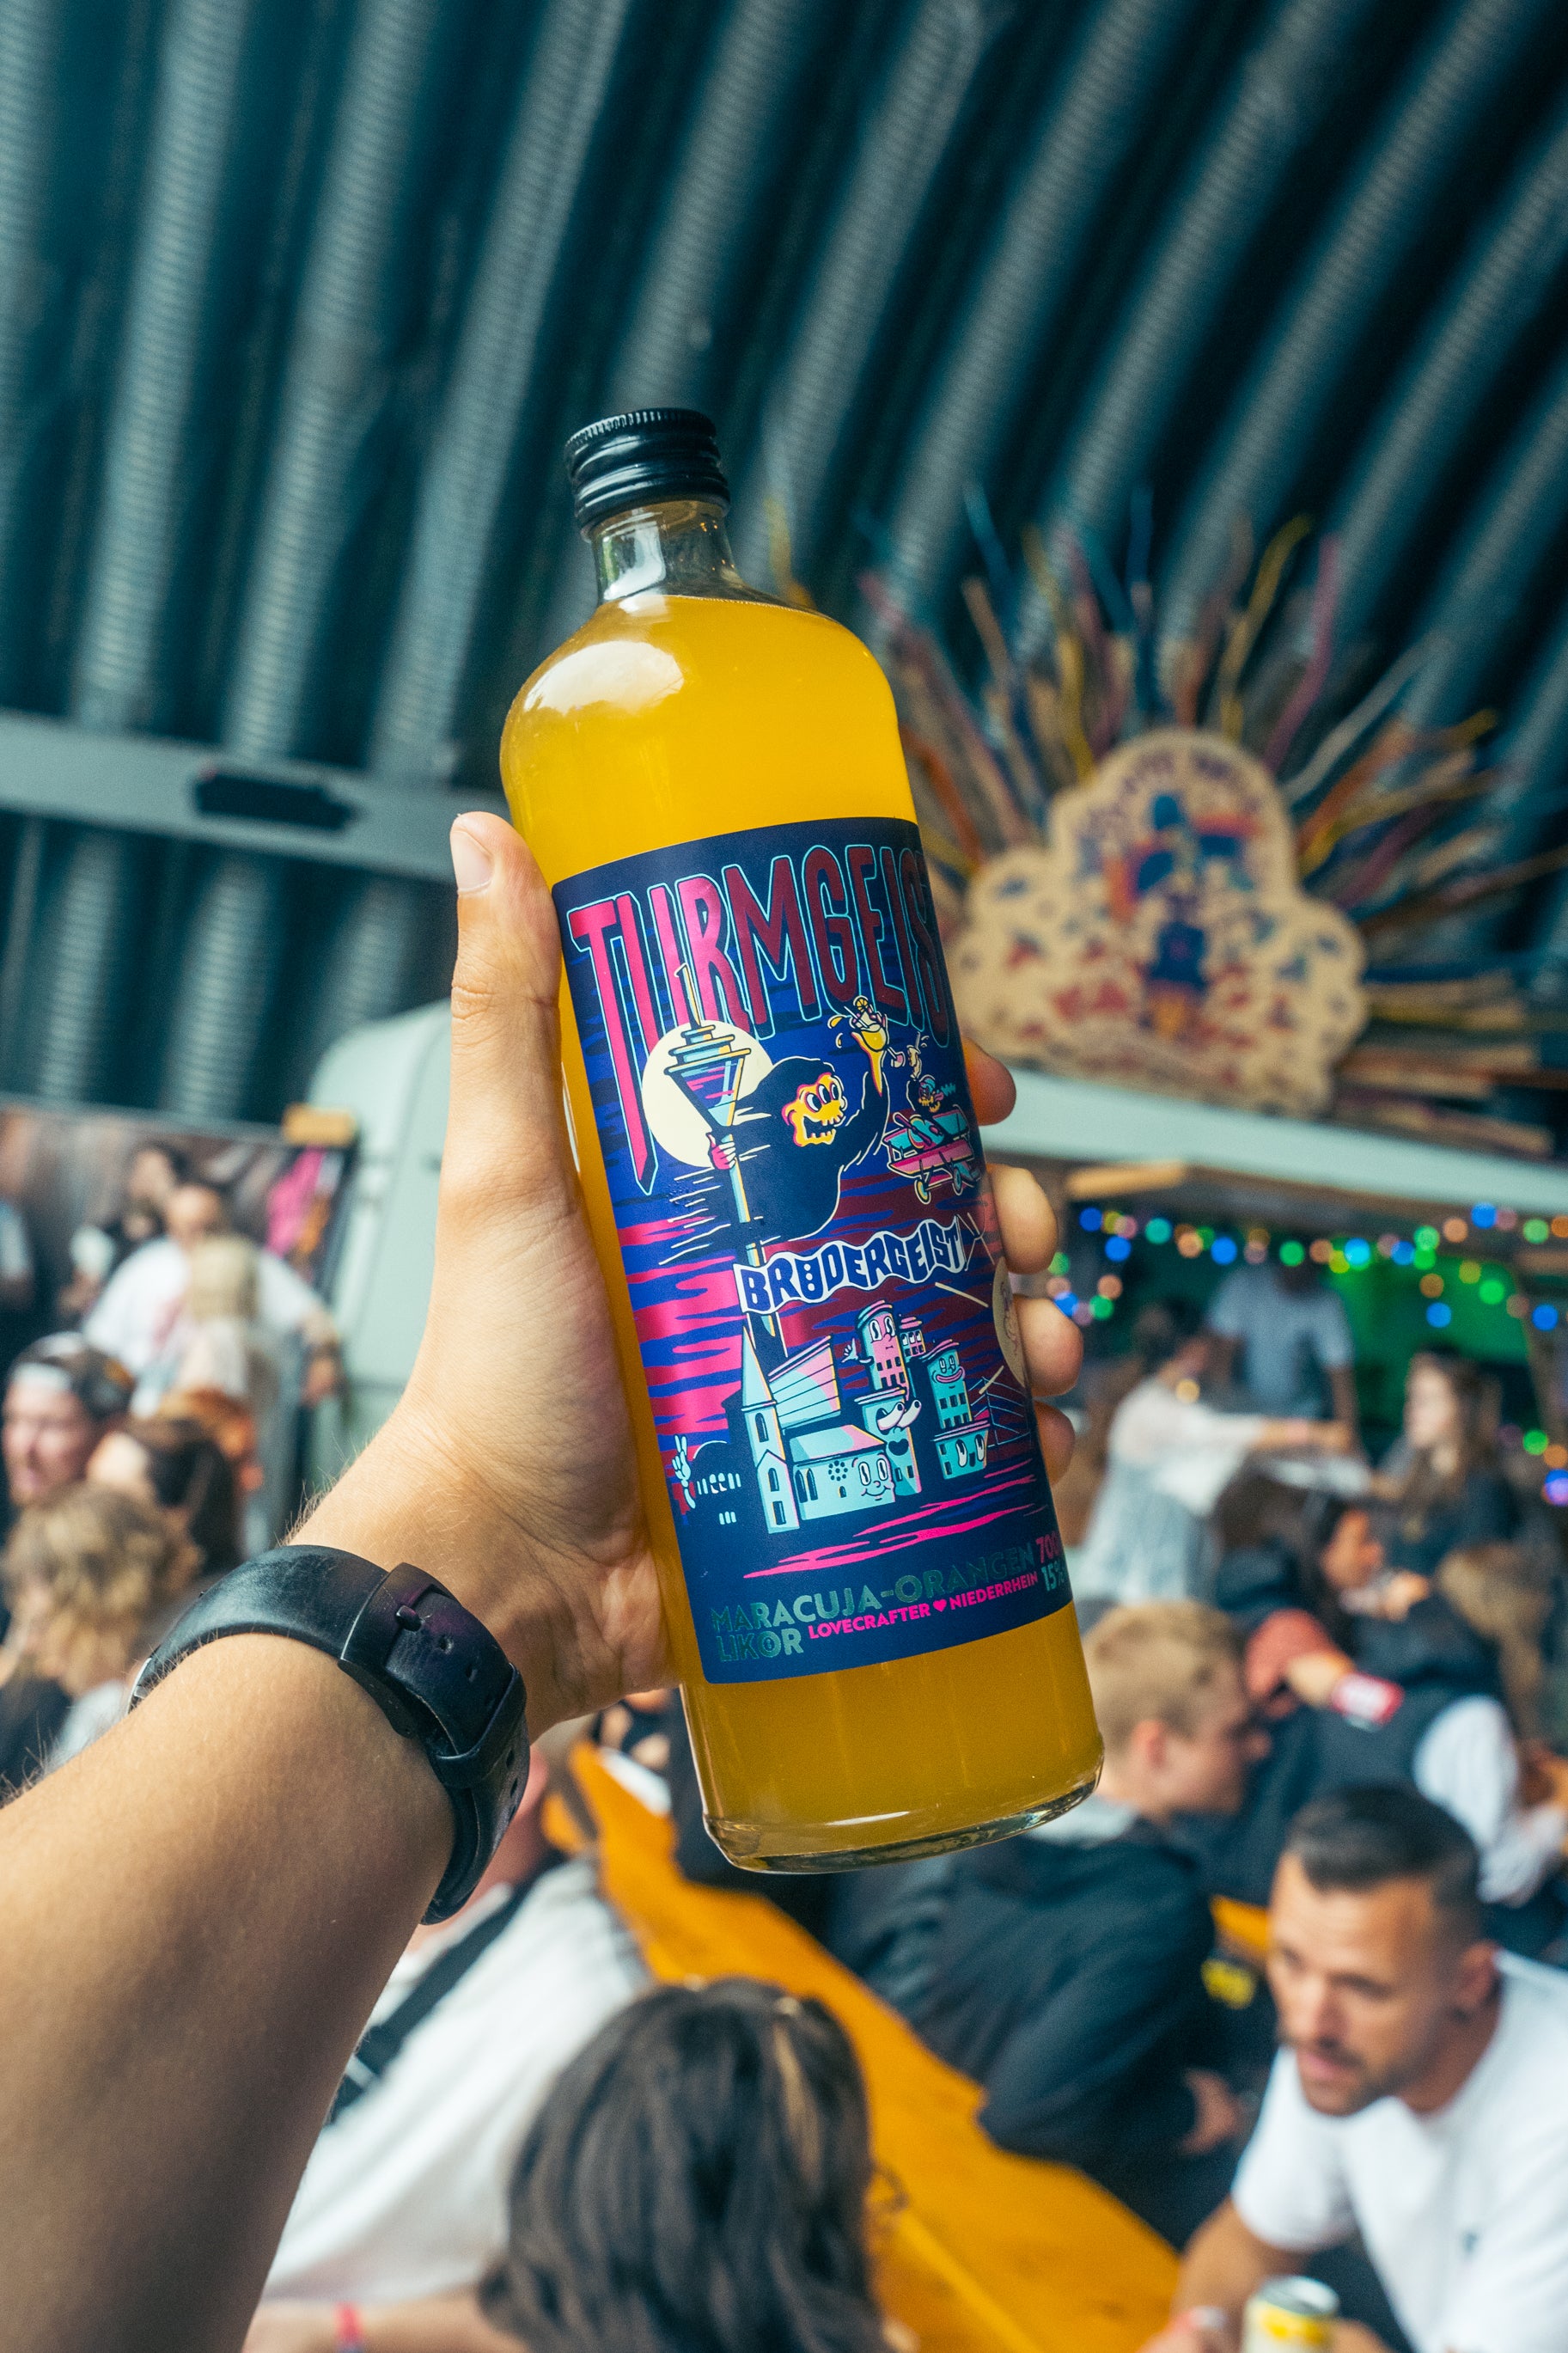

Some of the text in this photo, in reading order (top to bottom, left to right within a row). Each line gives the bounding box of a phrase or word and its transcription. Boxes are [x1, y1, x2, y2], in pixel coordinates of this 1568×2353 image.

[566, 845, 949, 1195] TURMGEIS
[711, 1542, 1036, 1633] MARACUJA-ORANGEN
[808, 1571, 1038, 1640] LOVECRAFTER NIEDERRHEIN
